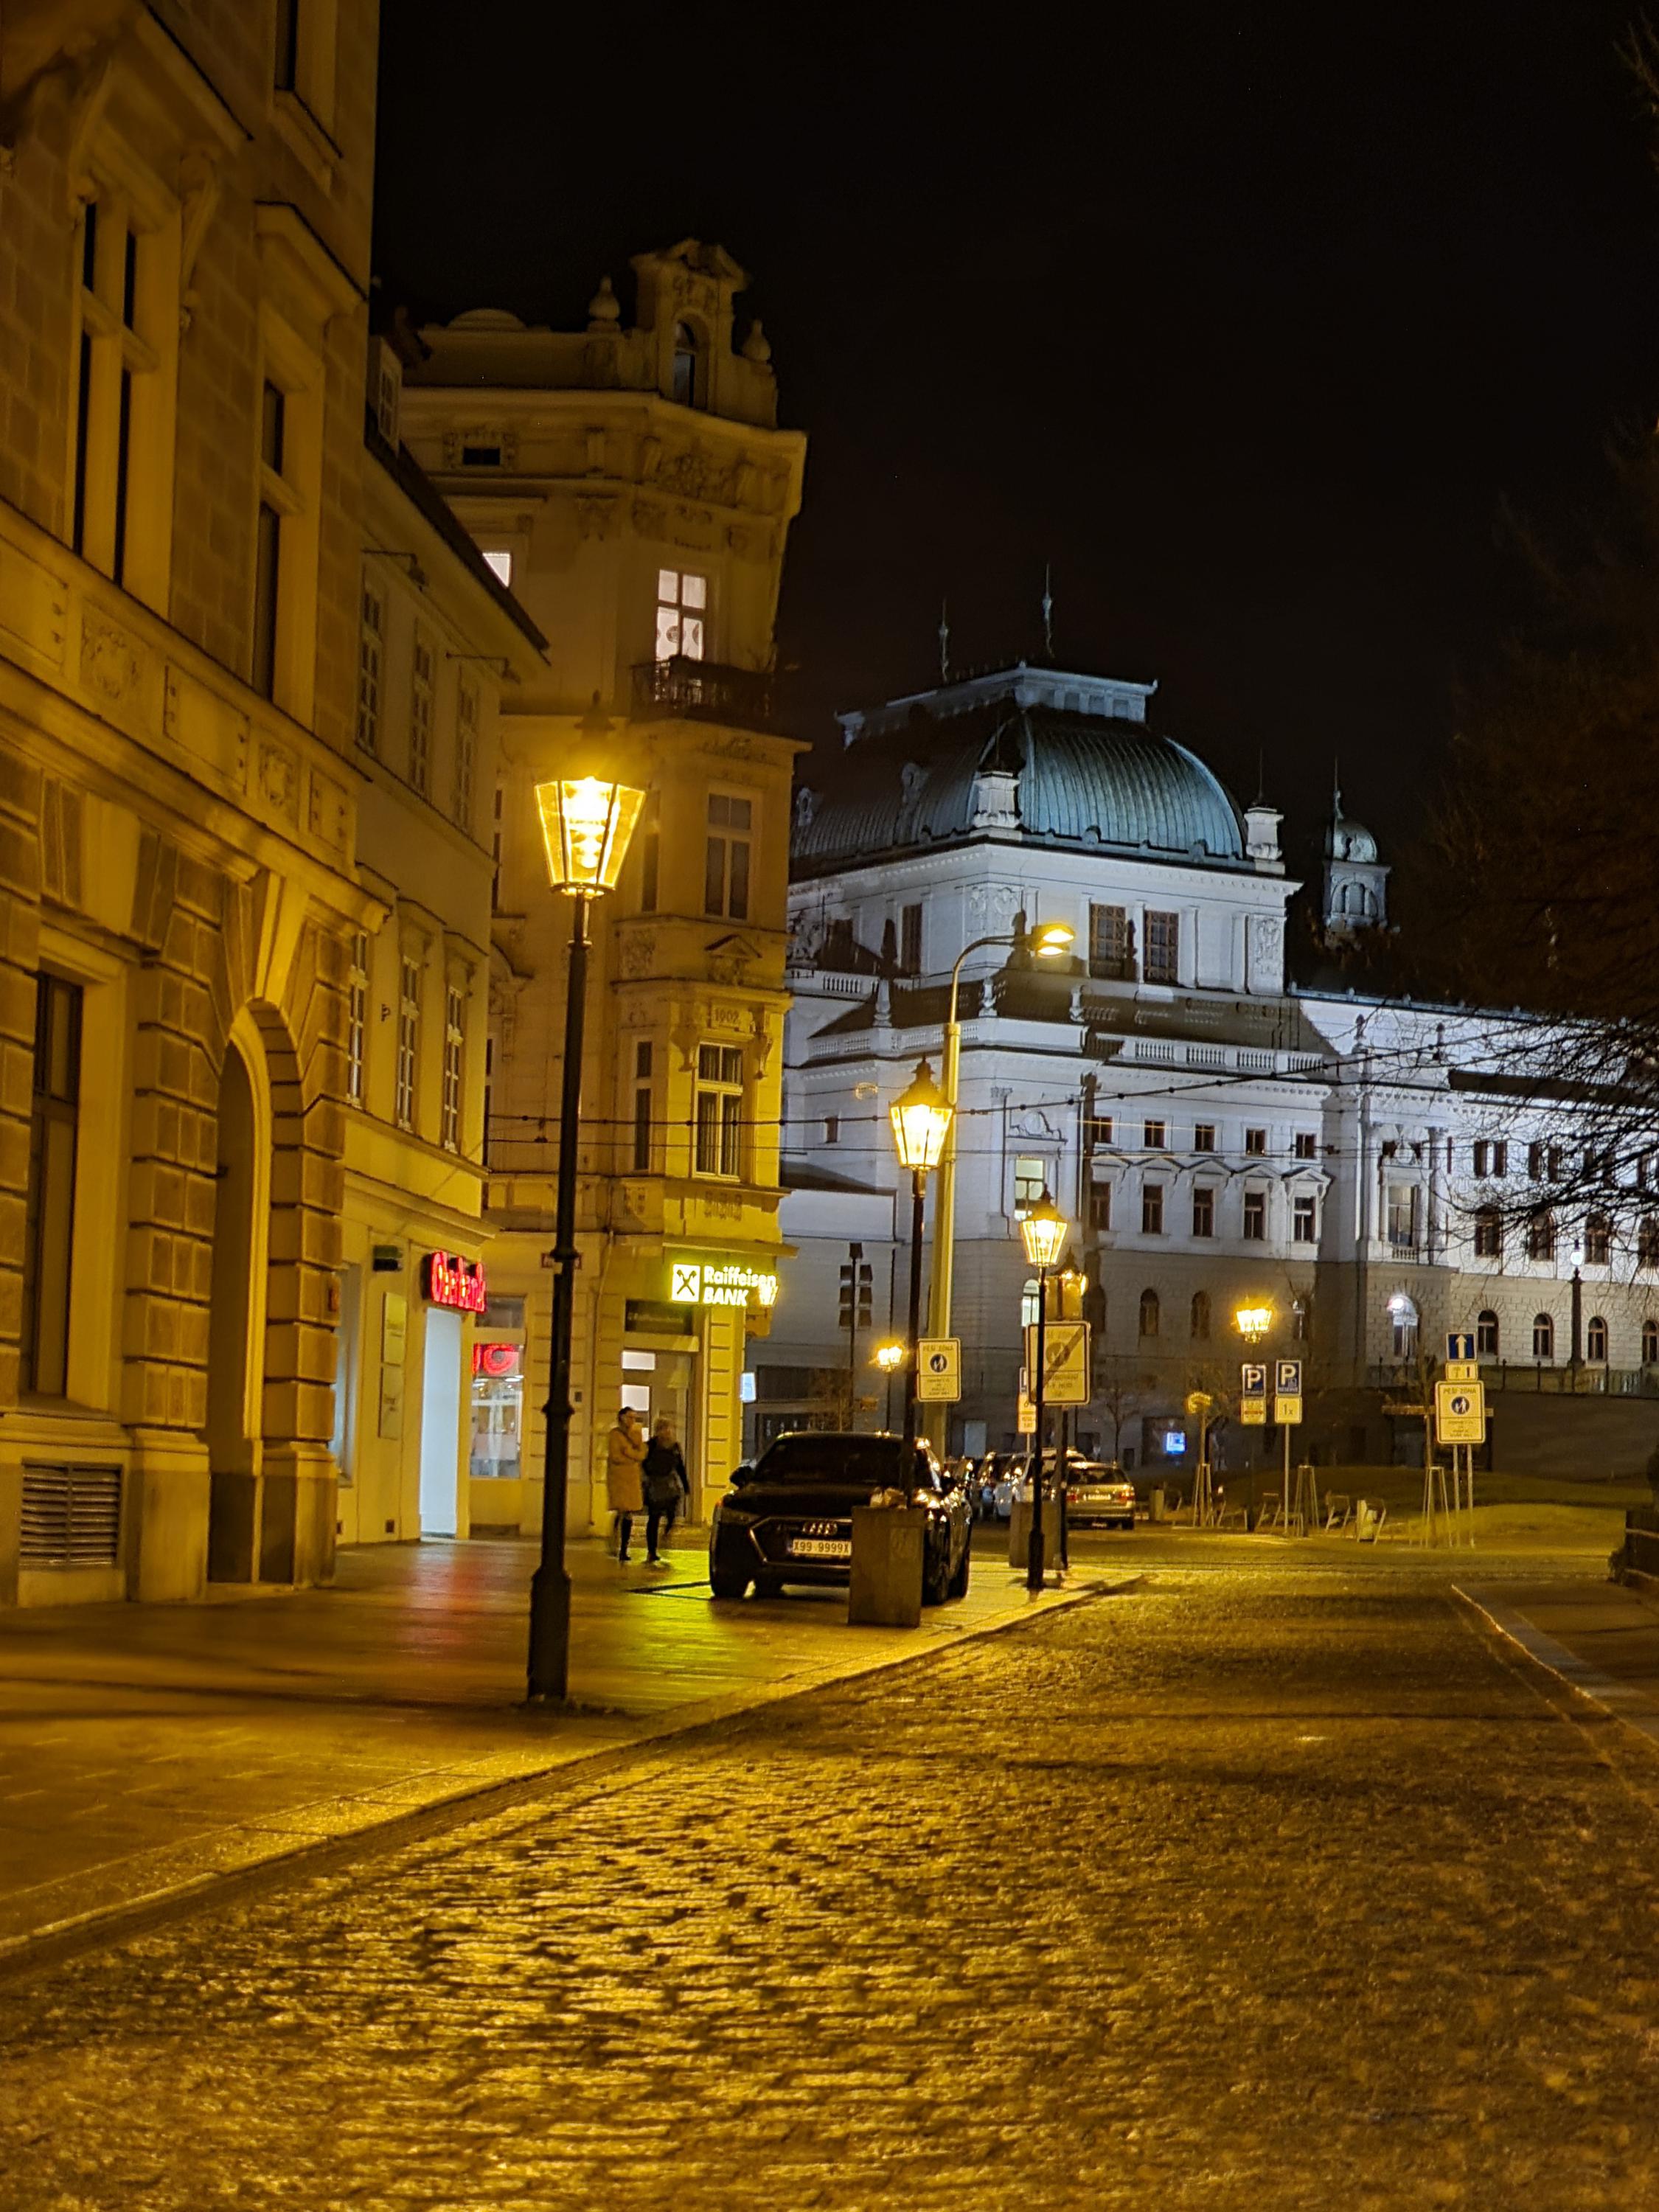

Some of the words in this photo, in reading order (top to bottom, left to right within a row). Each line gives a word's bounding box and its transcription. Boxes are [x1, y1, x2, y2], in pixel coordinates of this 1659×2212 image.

[703, 1265, 776, 1287] Raiffeisen
[703, 1286, 749, 1307] BANK
[1247, 1369, 1261, 1389] P
[1281, 1364, 1296, 1385] P
